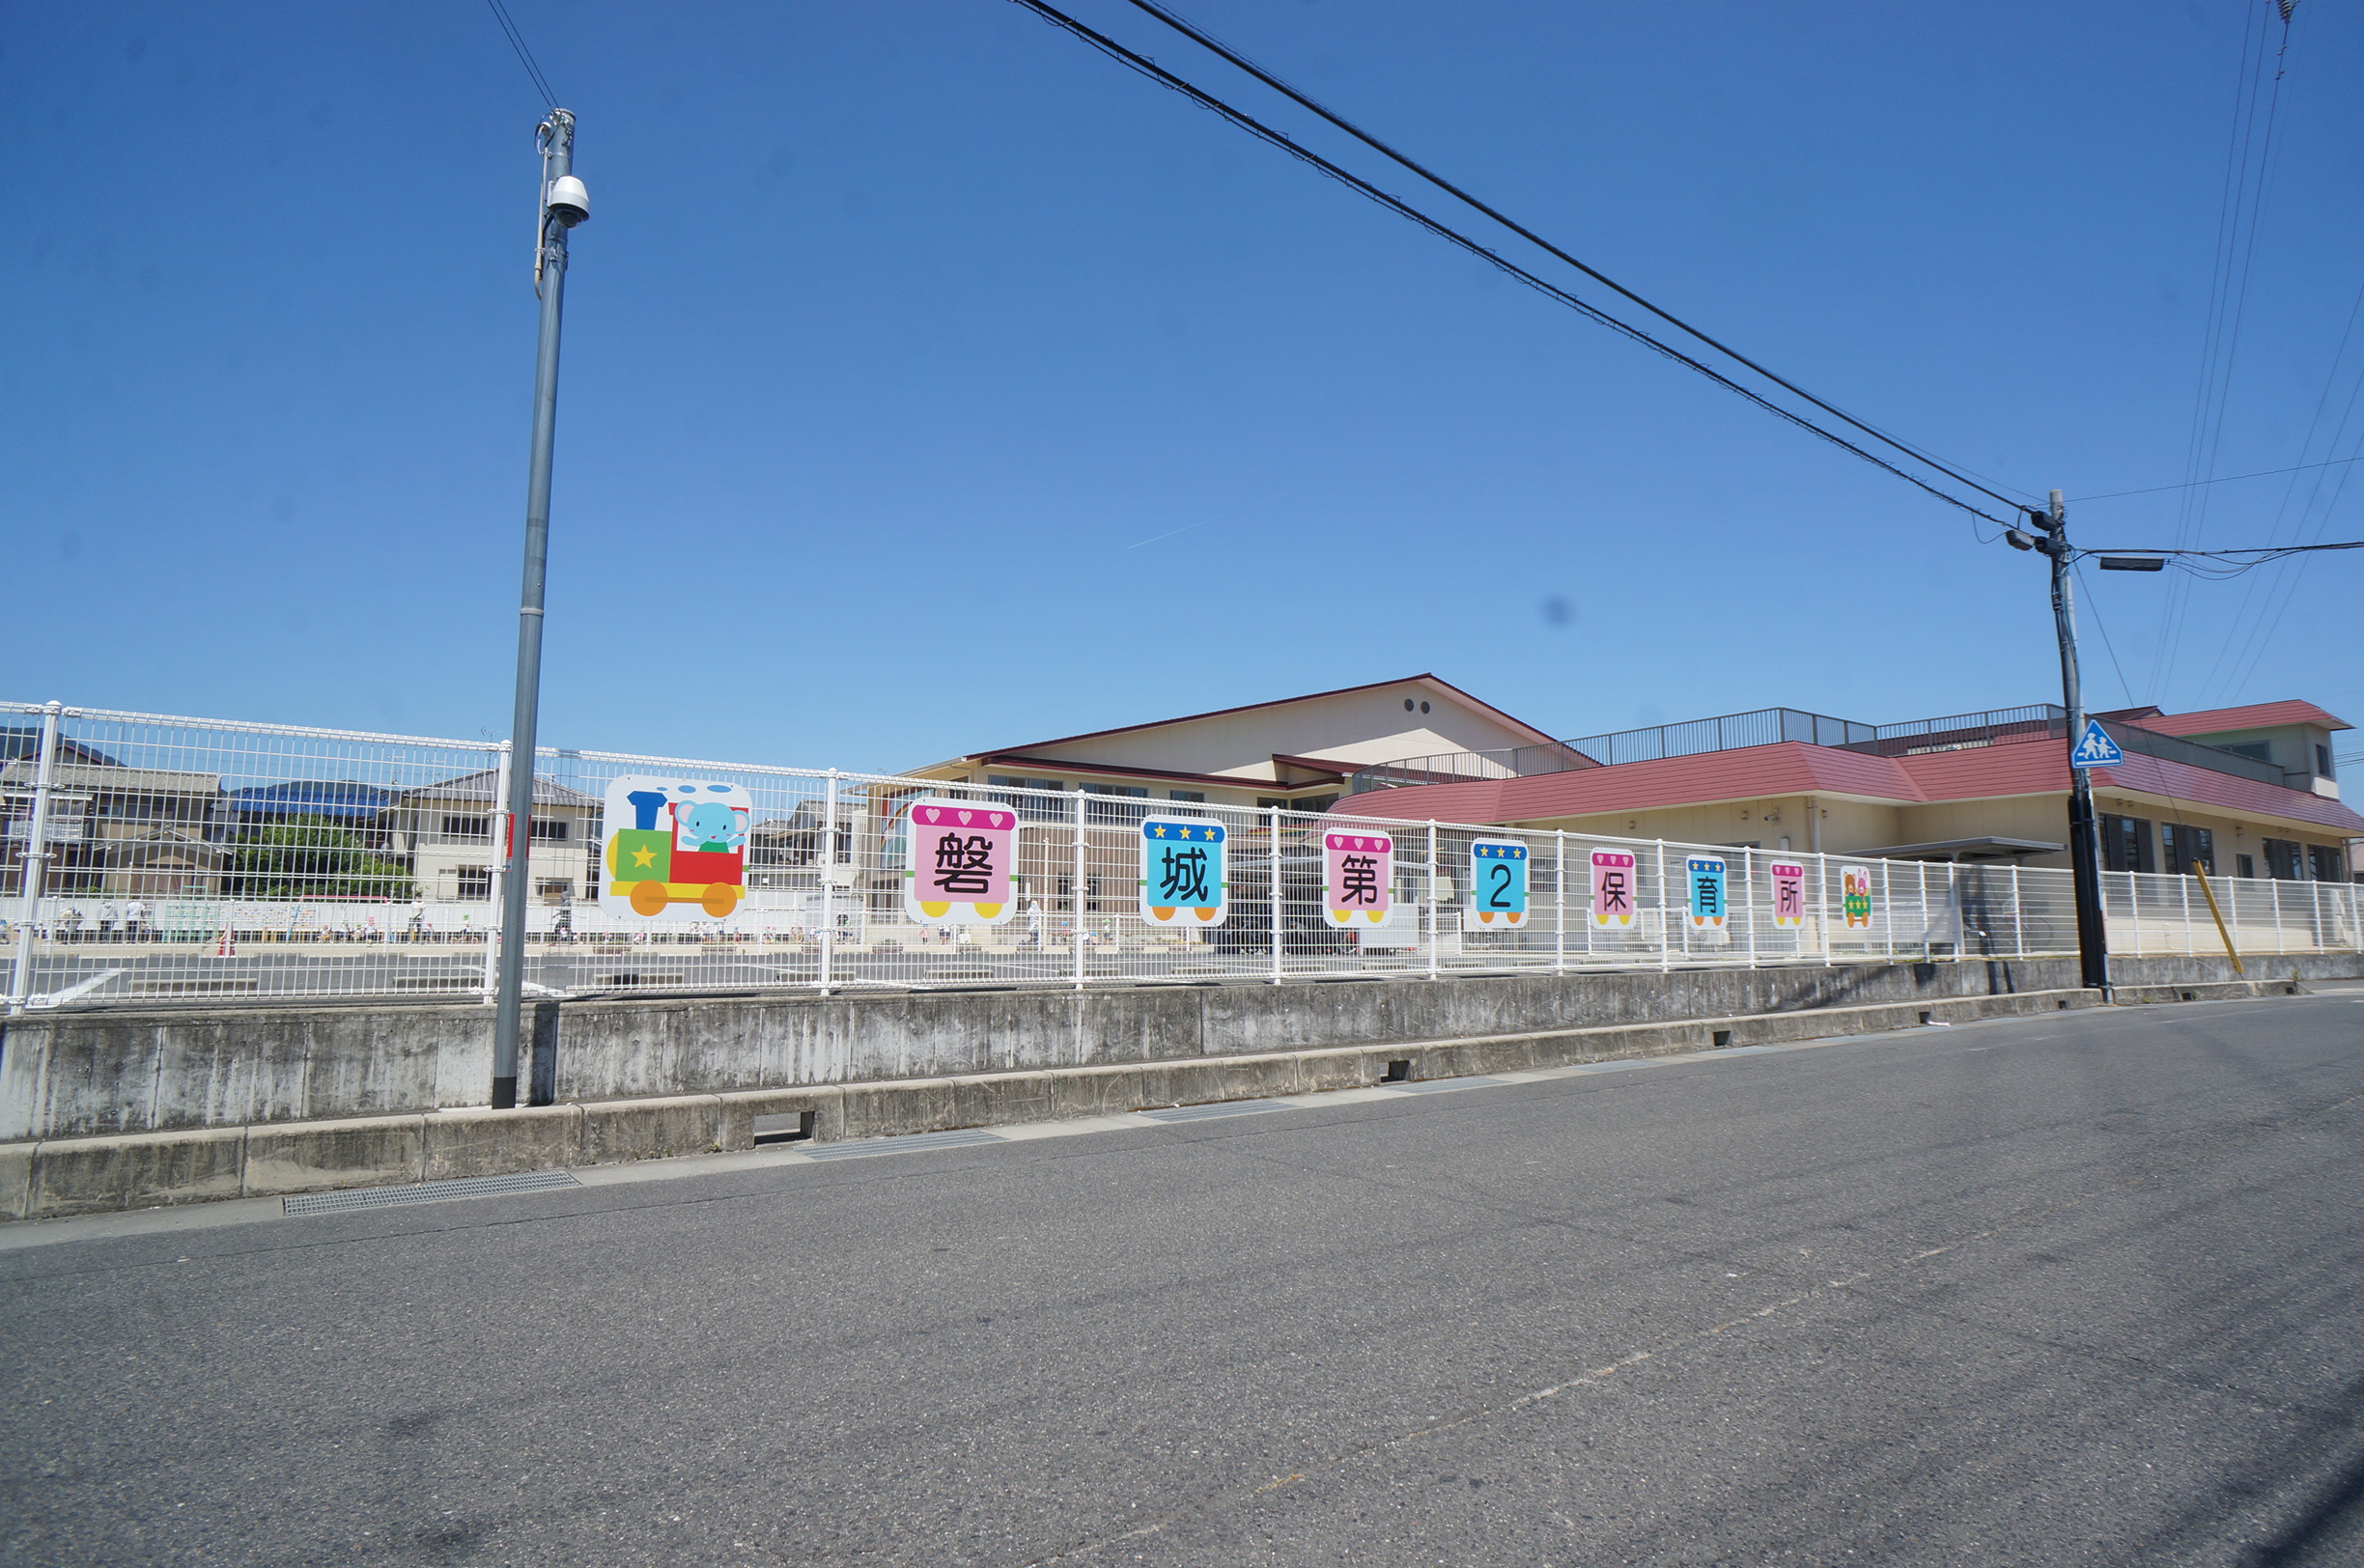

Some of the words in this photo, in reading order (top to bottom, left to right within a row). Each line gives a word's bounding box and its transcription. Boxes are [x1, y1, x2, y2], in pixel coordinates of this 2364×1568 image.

[934, 832, 994, 894] 磐
[1160, 847, 1208, 902] 城
[1341, 854, 1378, 906] 第
[1490, 864, 1511, 908] 2
[1601, 871, 1627, 911] 保
[1697, 876, 1718, 913] 育
[1780, 880, 1798, 913] 所
